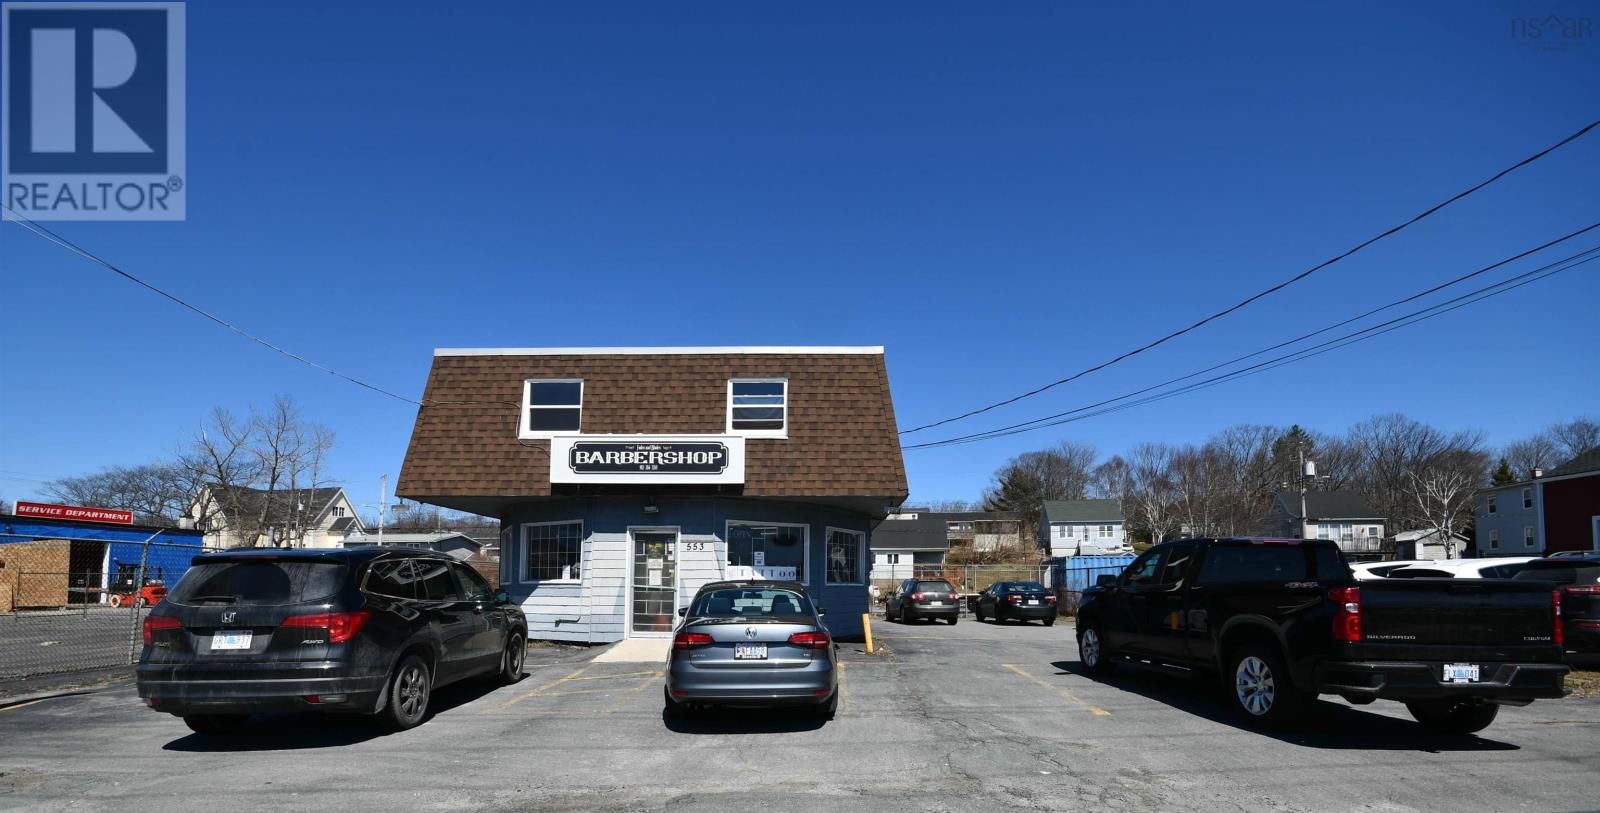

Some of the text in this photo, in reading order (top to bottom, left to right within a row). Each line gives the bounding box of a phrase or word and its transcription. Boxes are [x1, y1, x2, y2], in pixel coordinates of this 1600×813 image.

[575, 451, 723, 465] BARBERSHOP
[18, 505, 130, 521] SERVICE DEPARTMENT
[686, 542, 705, 551] 553
